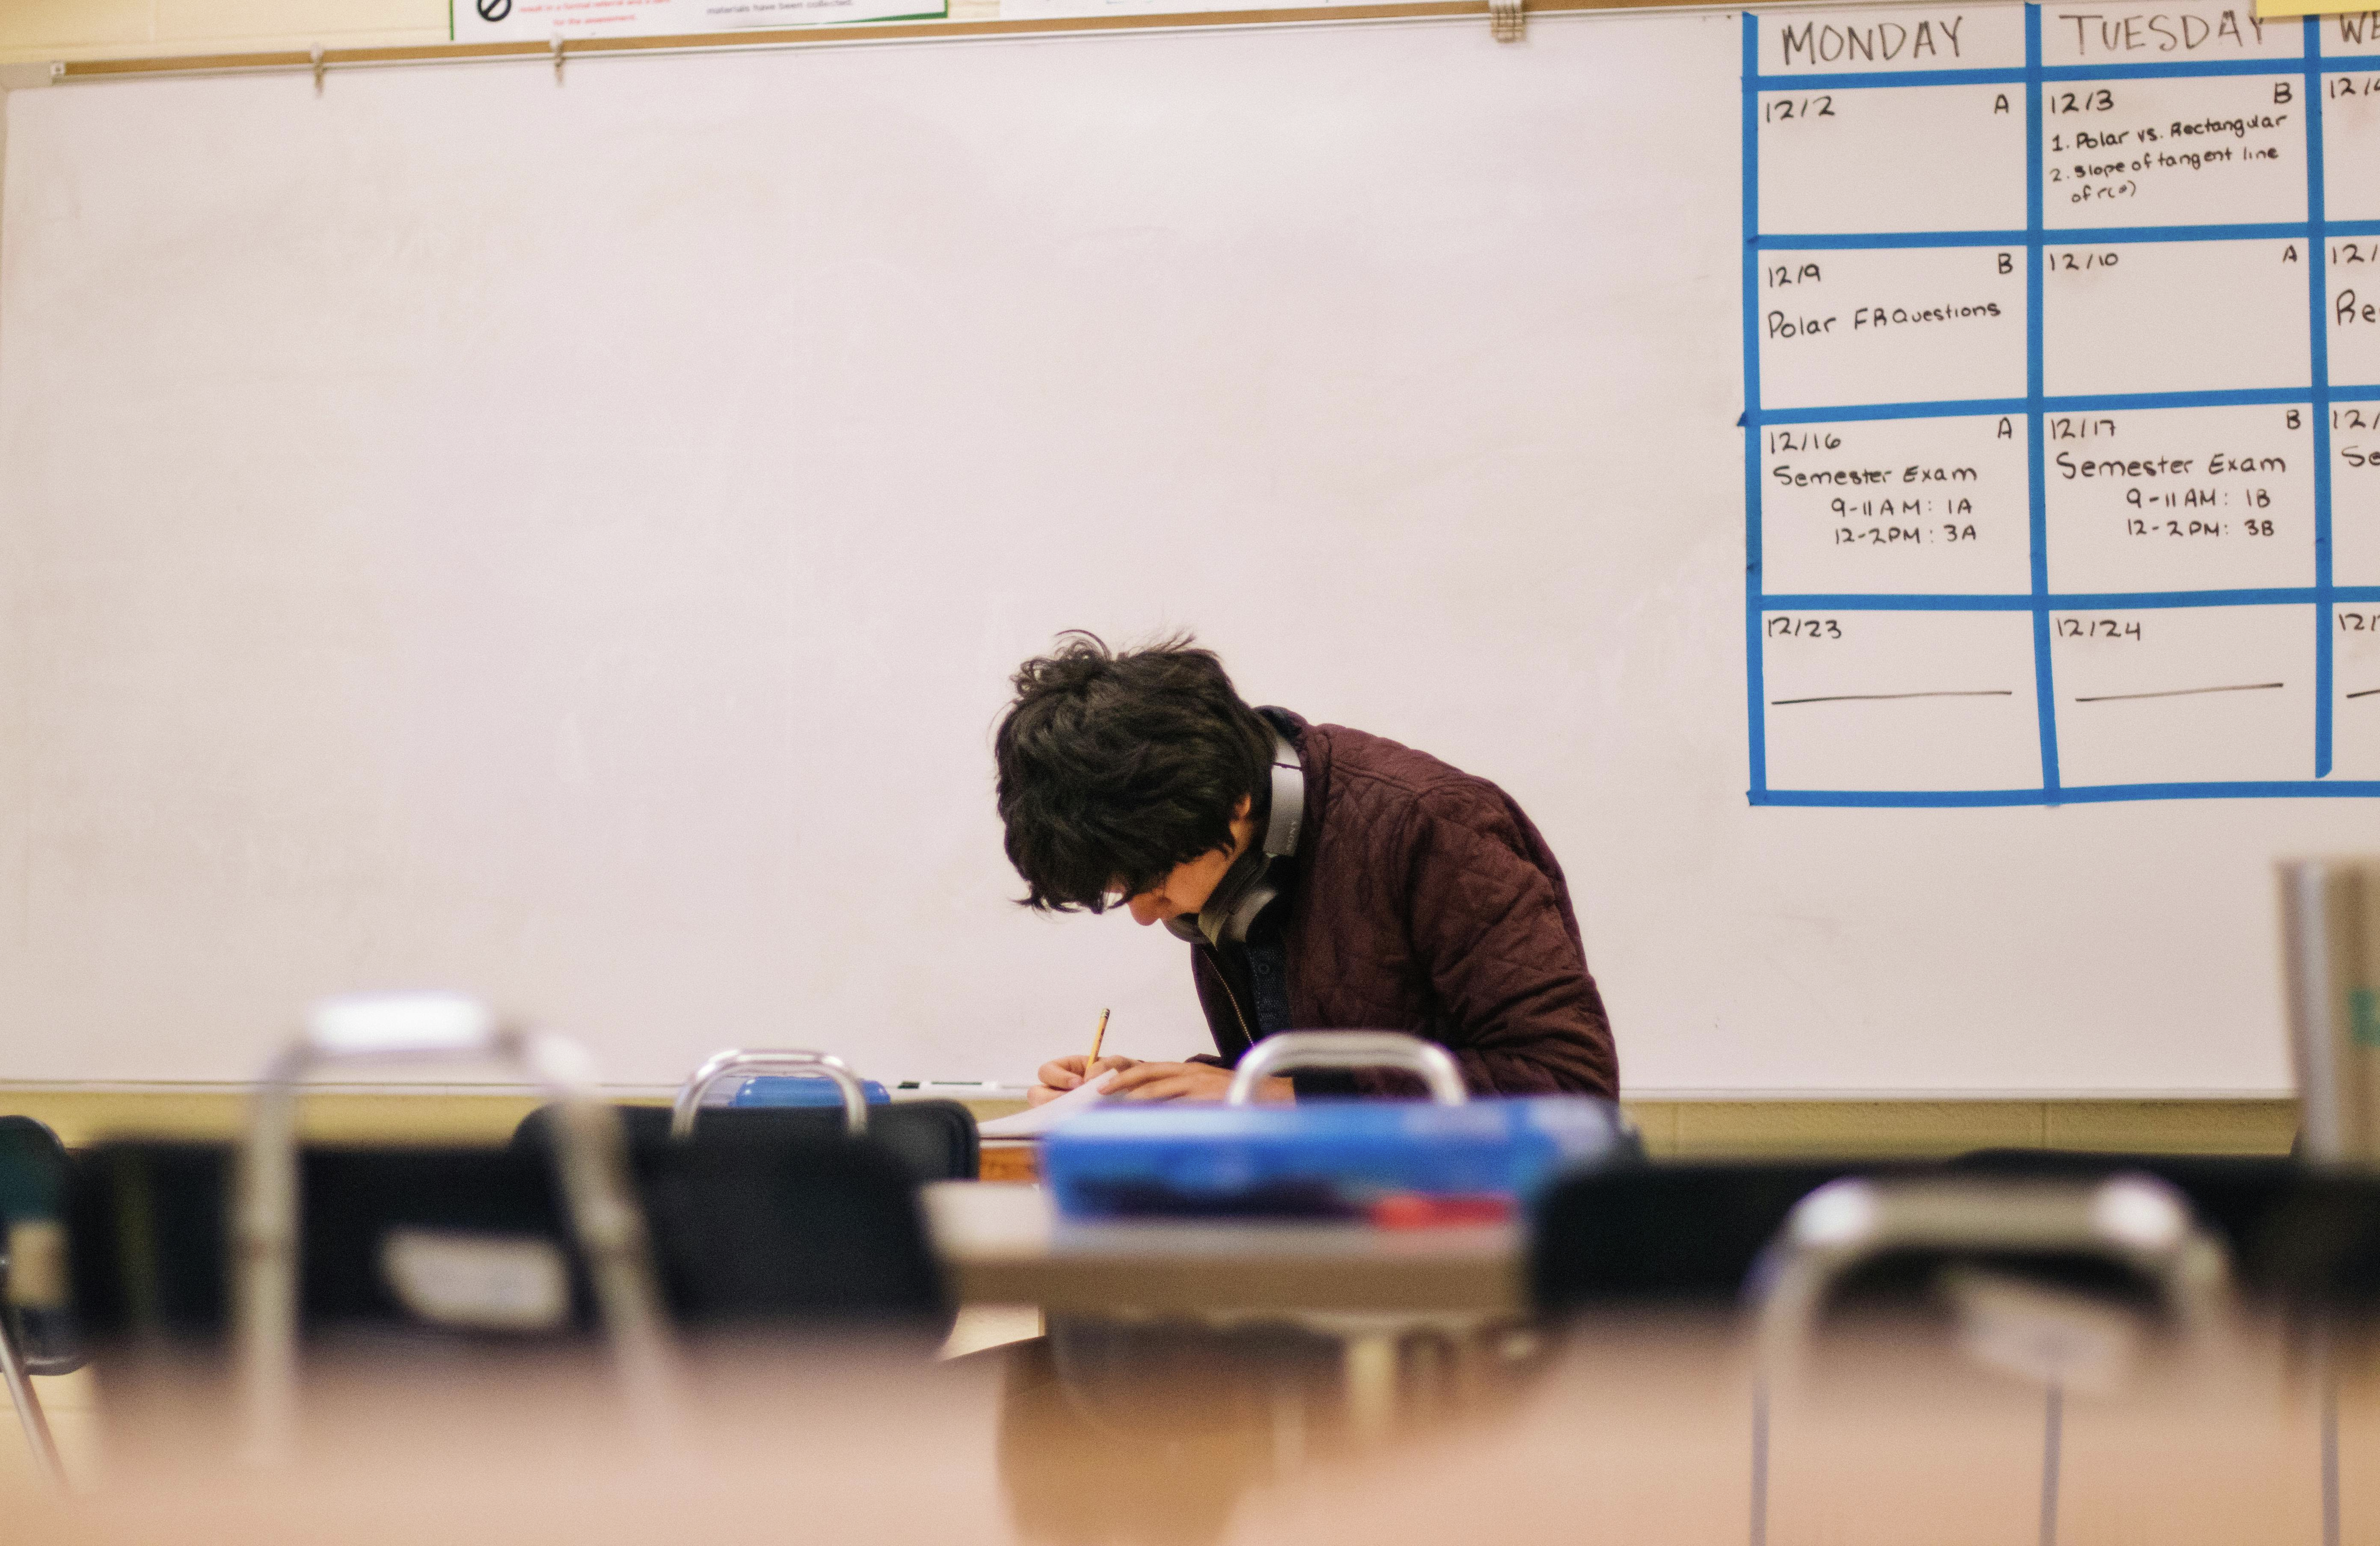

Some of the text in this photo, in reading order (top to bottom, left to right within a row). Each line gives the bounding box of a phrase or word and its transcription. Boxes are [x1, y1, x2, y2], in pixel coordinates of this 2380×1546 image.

[1782, 15, 1963, 66] MONDAY
[1994, 93, 2009, 114] A
[2051, 89, 2115, 114] 12/3
[2274, 82, 2293, 104] B
[1766, 95, 1836, 123] 12/2
[2052, 134, 2069, 152] 1.
[2076, 131, 2129, 149] Polar
[2170, 114, 2287, 139] Rectangular
[2050, 147, 2279, 182] 2. Slope of tangent line
[2071, 184, 2092, 203] of
[1998, 253, 2013, 275] B
[2050, 253, 2119, 271] 12/10
[2283, 244, 2298, 262] A
[1769, 263, 1821, 288] 12/9
[1768, 310, 1837, 339] Polar
[1998, 416, 2012, 439] A
[2051, 418, 2116, 440] 12/17
[2287, 409, 2301, 430] B
[1771, 431, 1841, 455] 12/16
[1772, 465, 1977, 488] Semester Exam
[2056, 451, 2286, 480] Semester Exam
[1948, 498, 1972, 514] 1A
[2246, 489, 2271, 508] 1B
[1943, 524, 1977, 542] 3A
[2244, 519, 2274, 536] 3B
[1768, 616, 1842, 640] 12/23
[2057, 618, 2141, 641] 12/24
[2339, 613, 2380, 632] 12/
